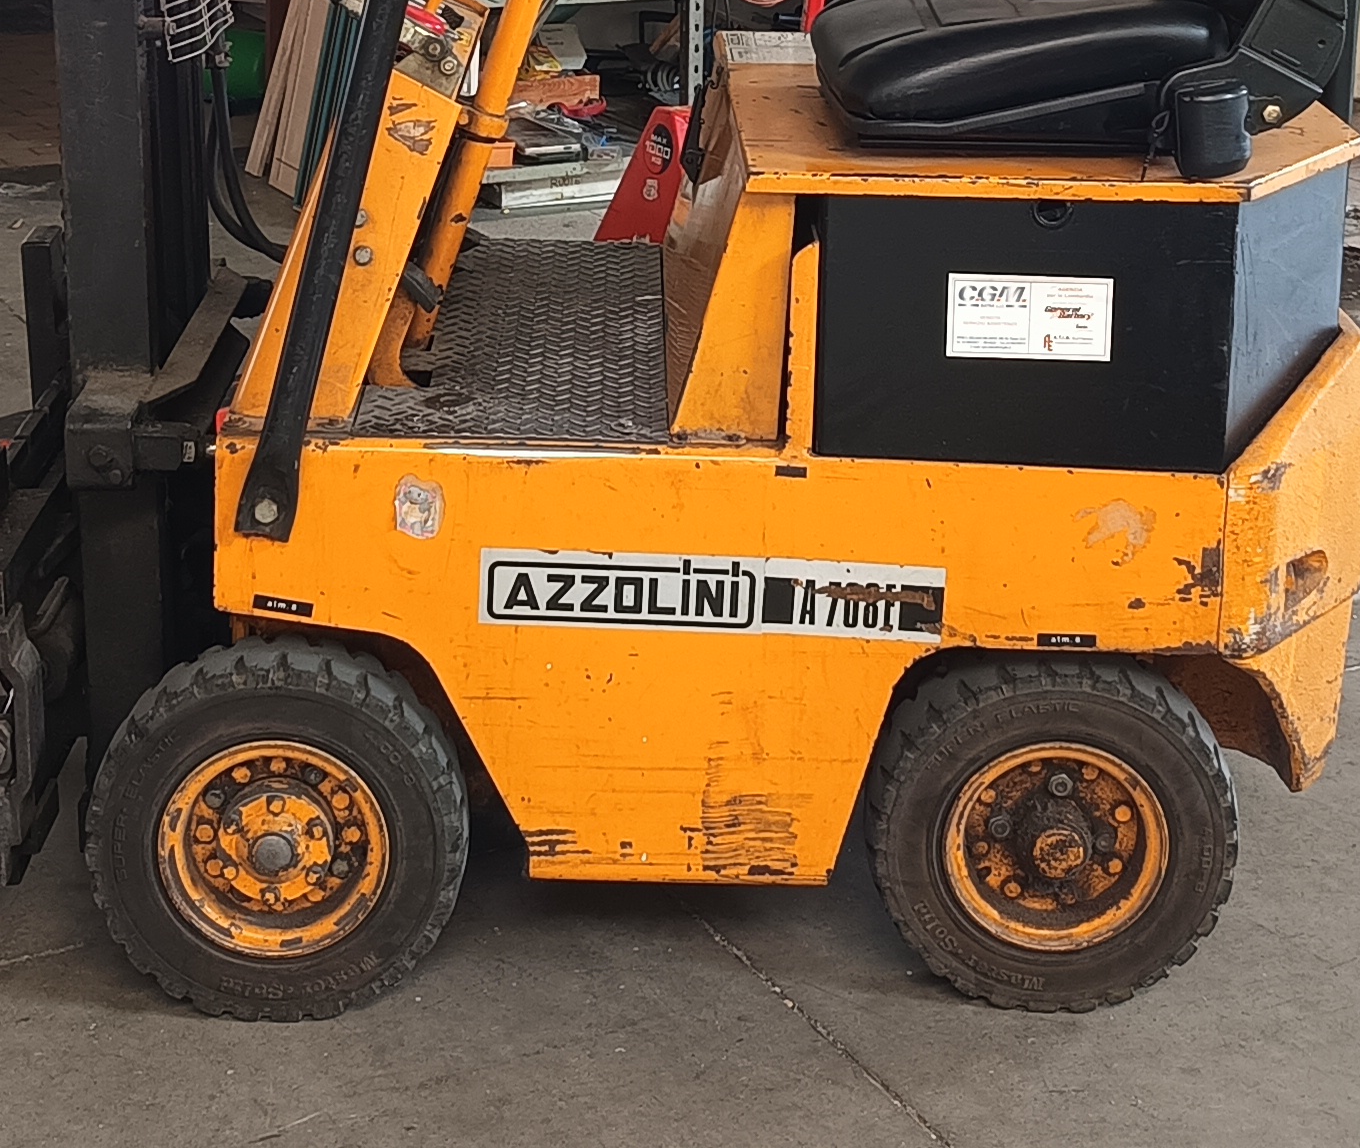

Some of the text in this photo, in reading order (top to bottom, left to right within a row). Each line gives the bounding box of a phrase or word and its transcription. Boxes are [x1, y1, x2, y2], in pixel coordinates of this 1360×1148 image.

[650, 134, 668, 144] MAX
[645, 141, 671, 160] 1000
[503, 558, 741, 618] AZZOLINI
[799, 579, 816, 625] A
